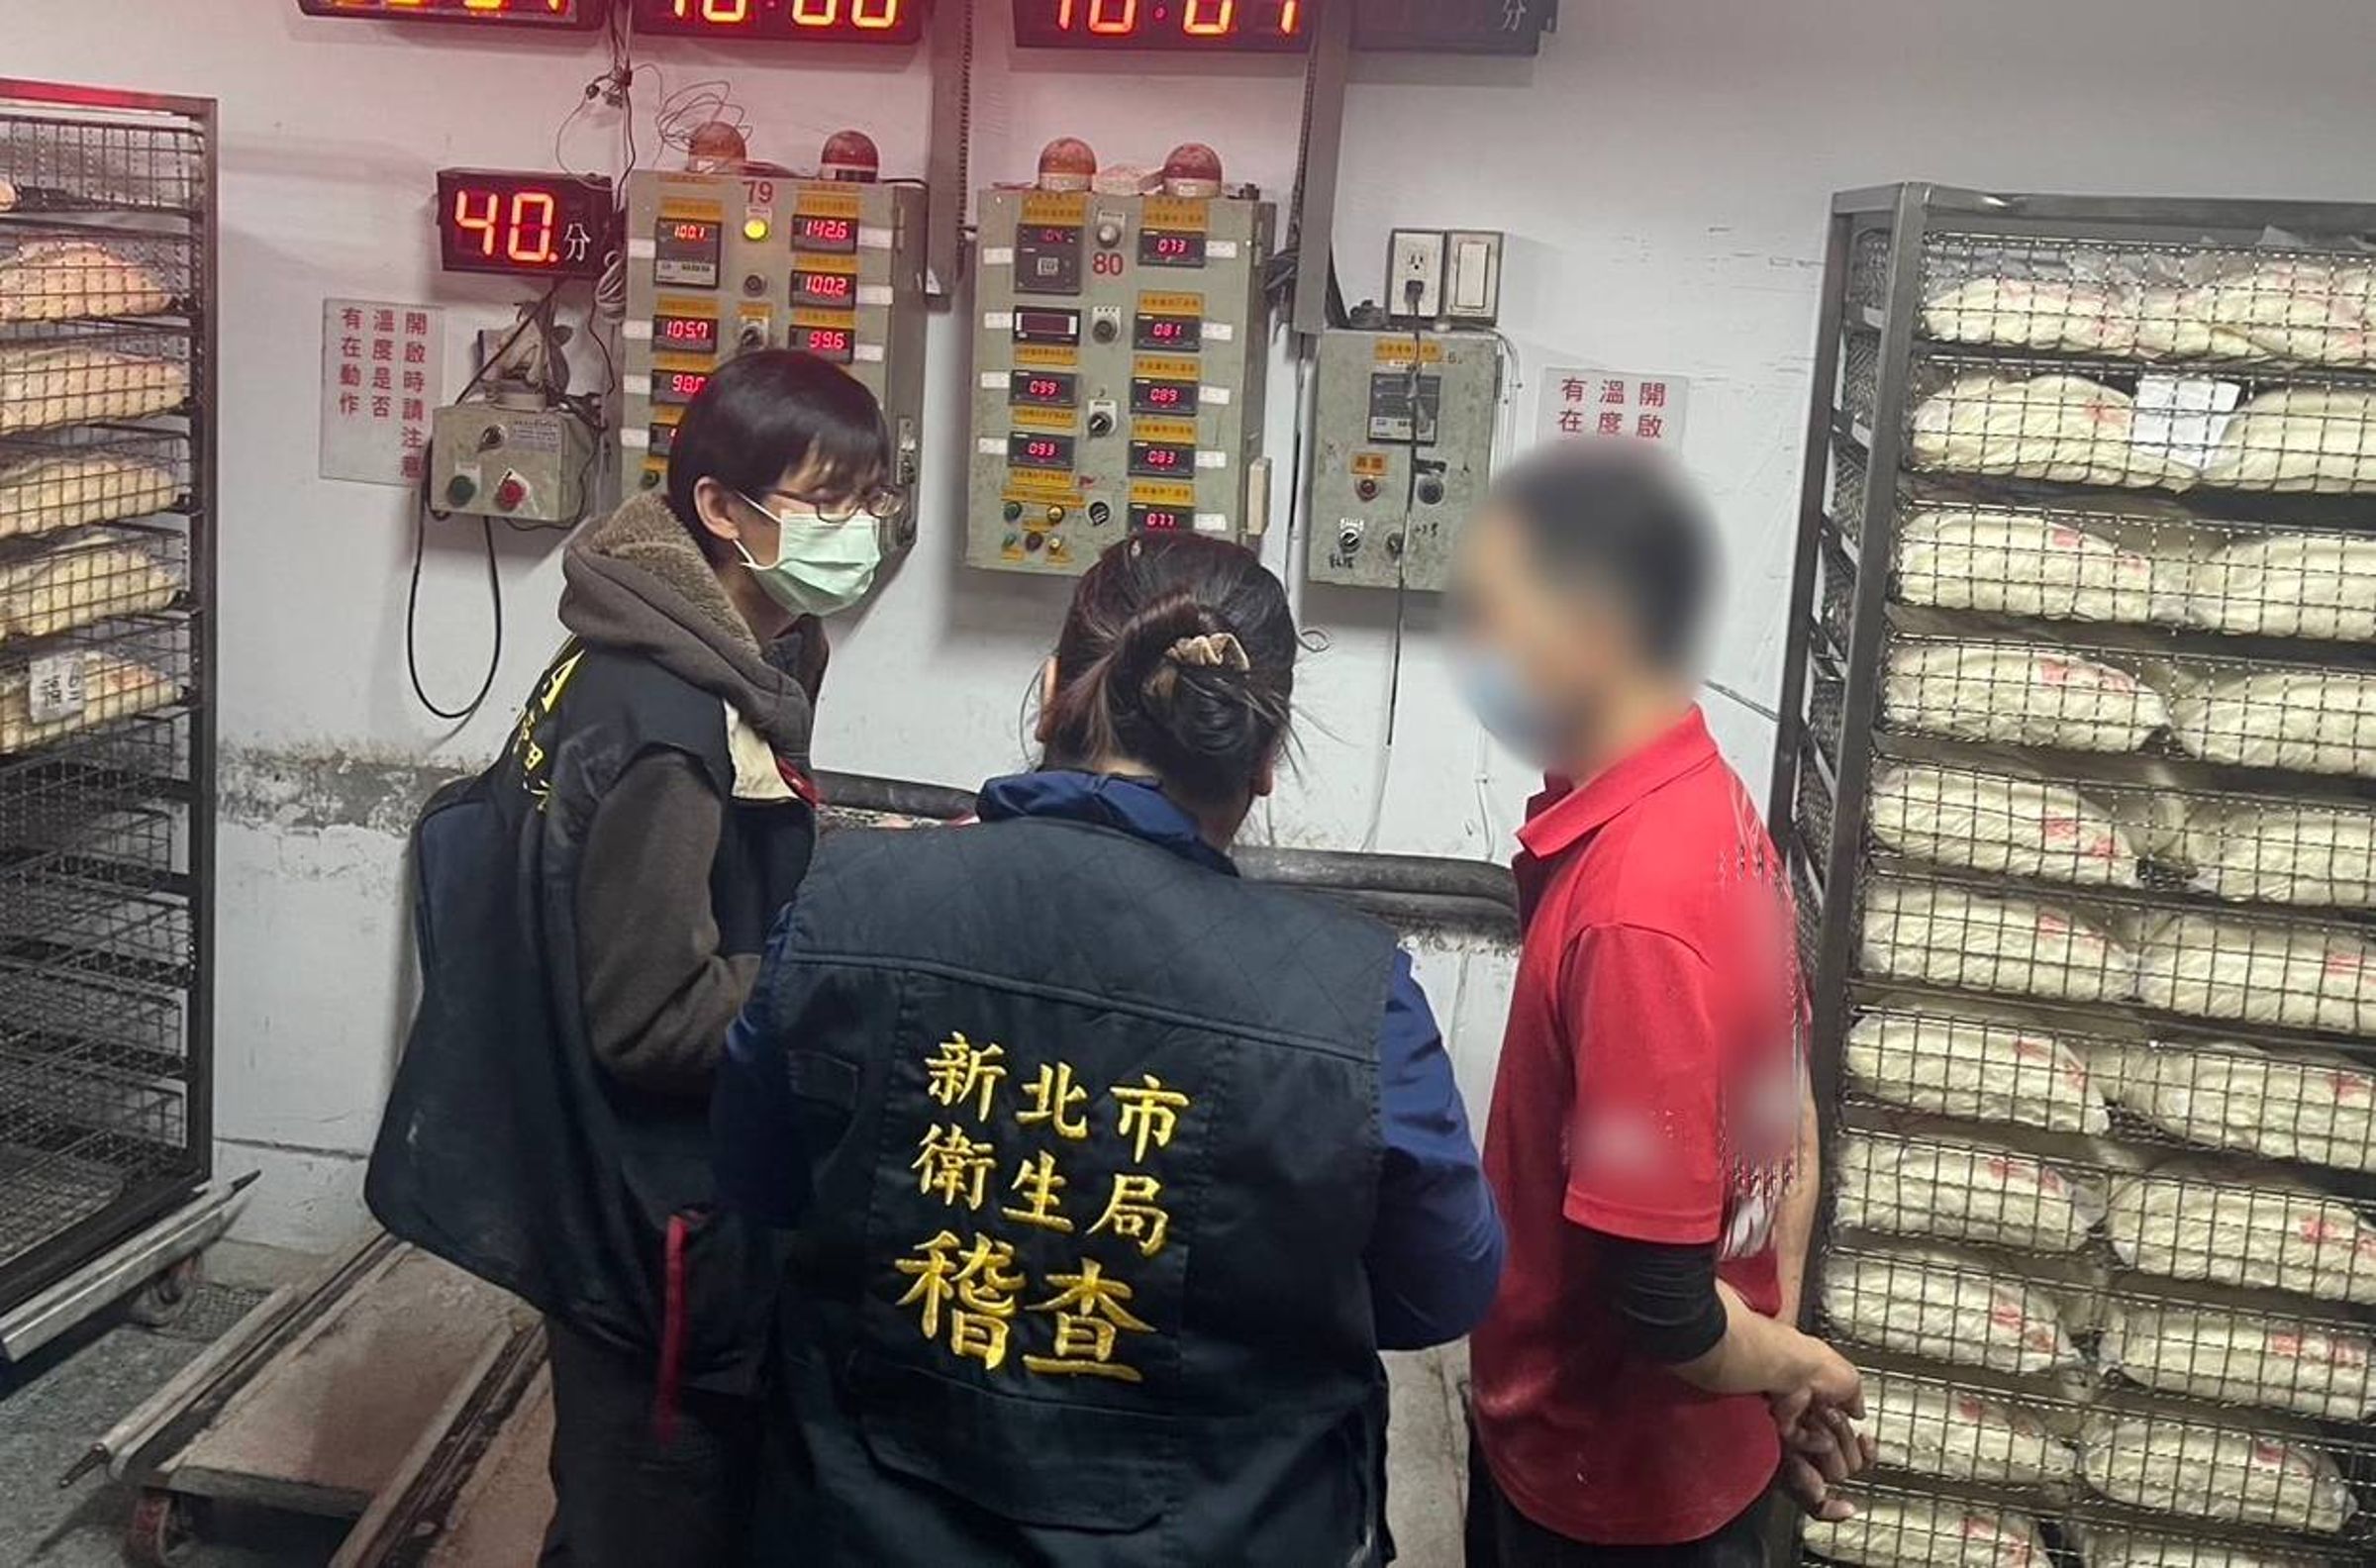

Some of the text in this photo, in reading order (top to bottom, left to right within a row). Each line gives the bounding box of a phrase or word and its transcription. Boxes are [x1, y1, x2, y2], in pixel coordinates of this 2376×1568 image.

[742, 180, 774, 204] 79
[1092, 250, 1124, 275] 80
[925, 1029, 1190, 1164] 新北市
[911, 1123, 1169, 1257] 衛生局
[894, 1229, 1157, 1383] 稽查
